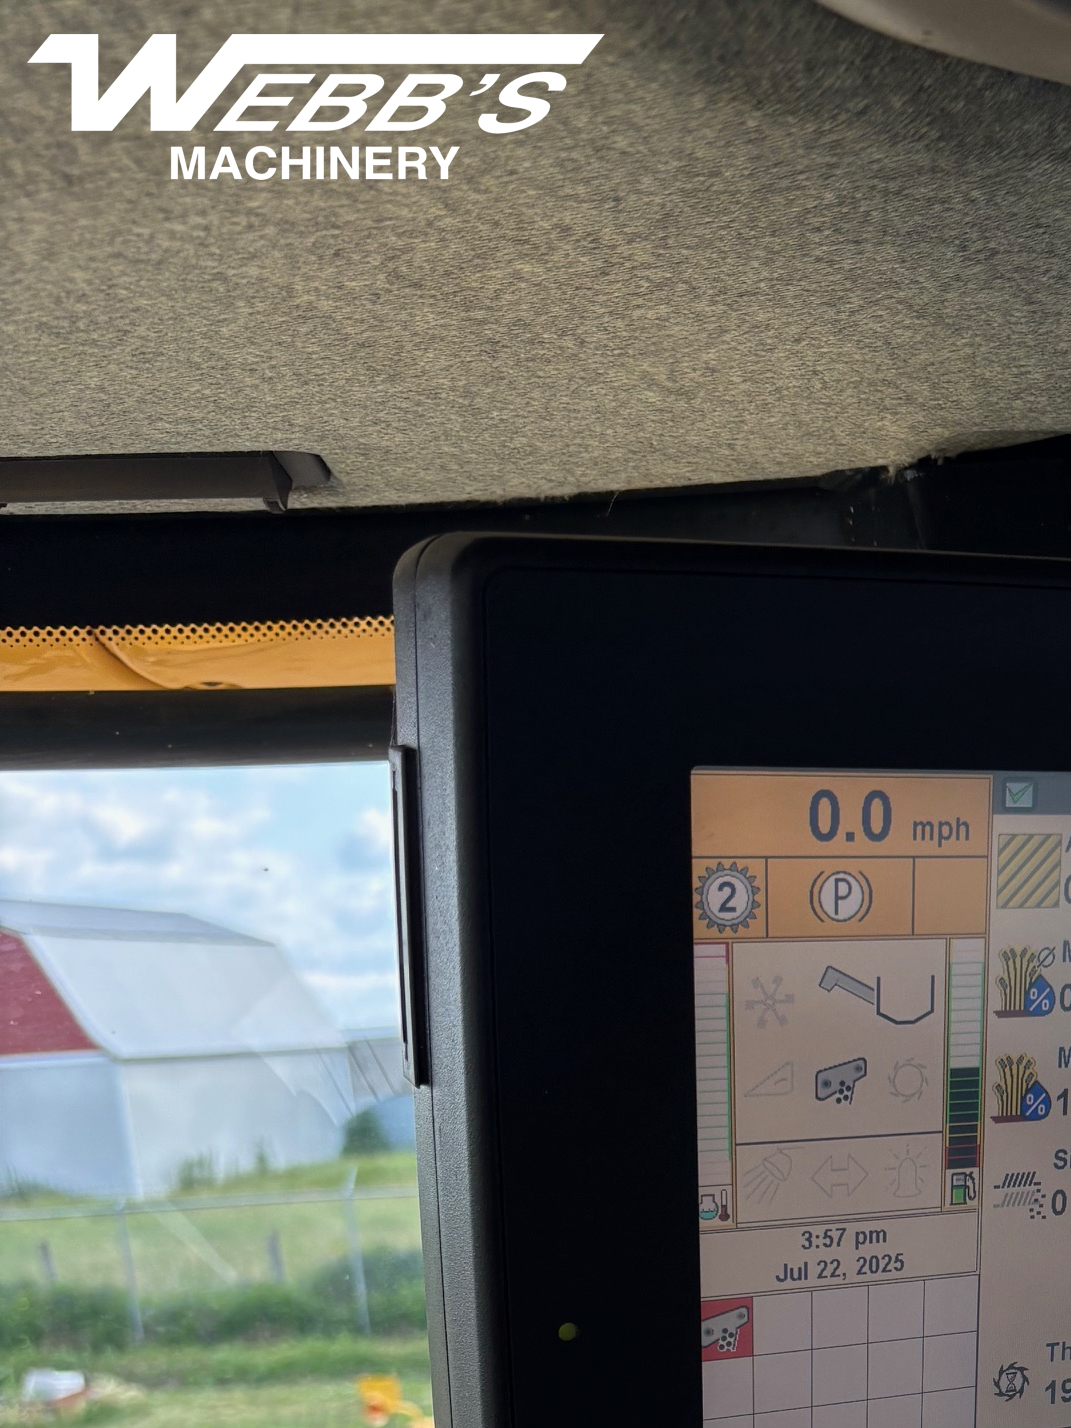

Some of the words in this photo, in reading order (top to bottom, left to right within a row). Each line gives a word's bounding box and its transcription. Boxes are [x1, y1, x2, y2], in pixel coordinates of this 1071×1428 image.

[809, 789, 892, 842] 0.0
[912, 817, 970, 848] mph
[717, 881, 737, 913] 2
[1051, 1189, 1068, 1216] 0
[801, 1227, 847, 1250] 3:57
[855, 1227, 888, 1250] pm
[775, 1262, 808, 1283] Jul
[817, 1259, 847, 1280] 22,
[856, 1253, 905, 1276] 2025
